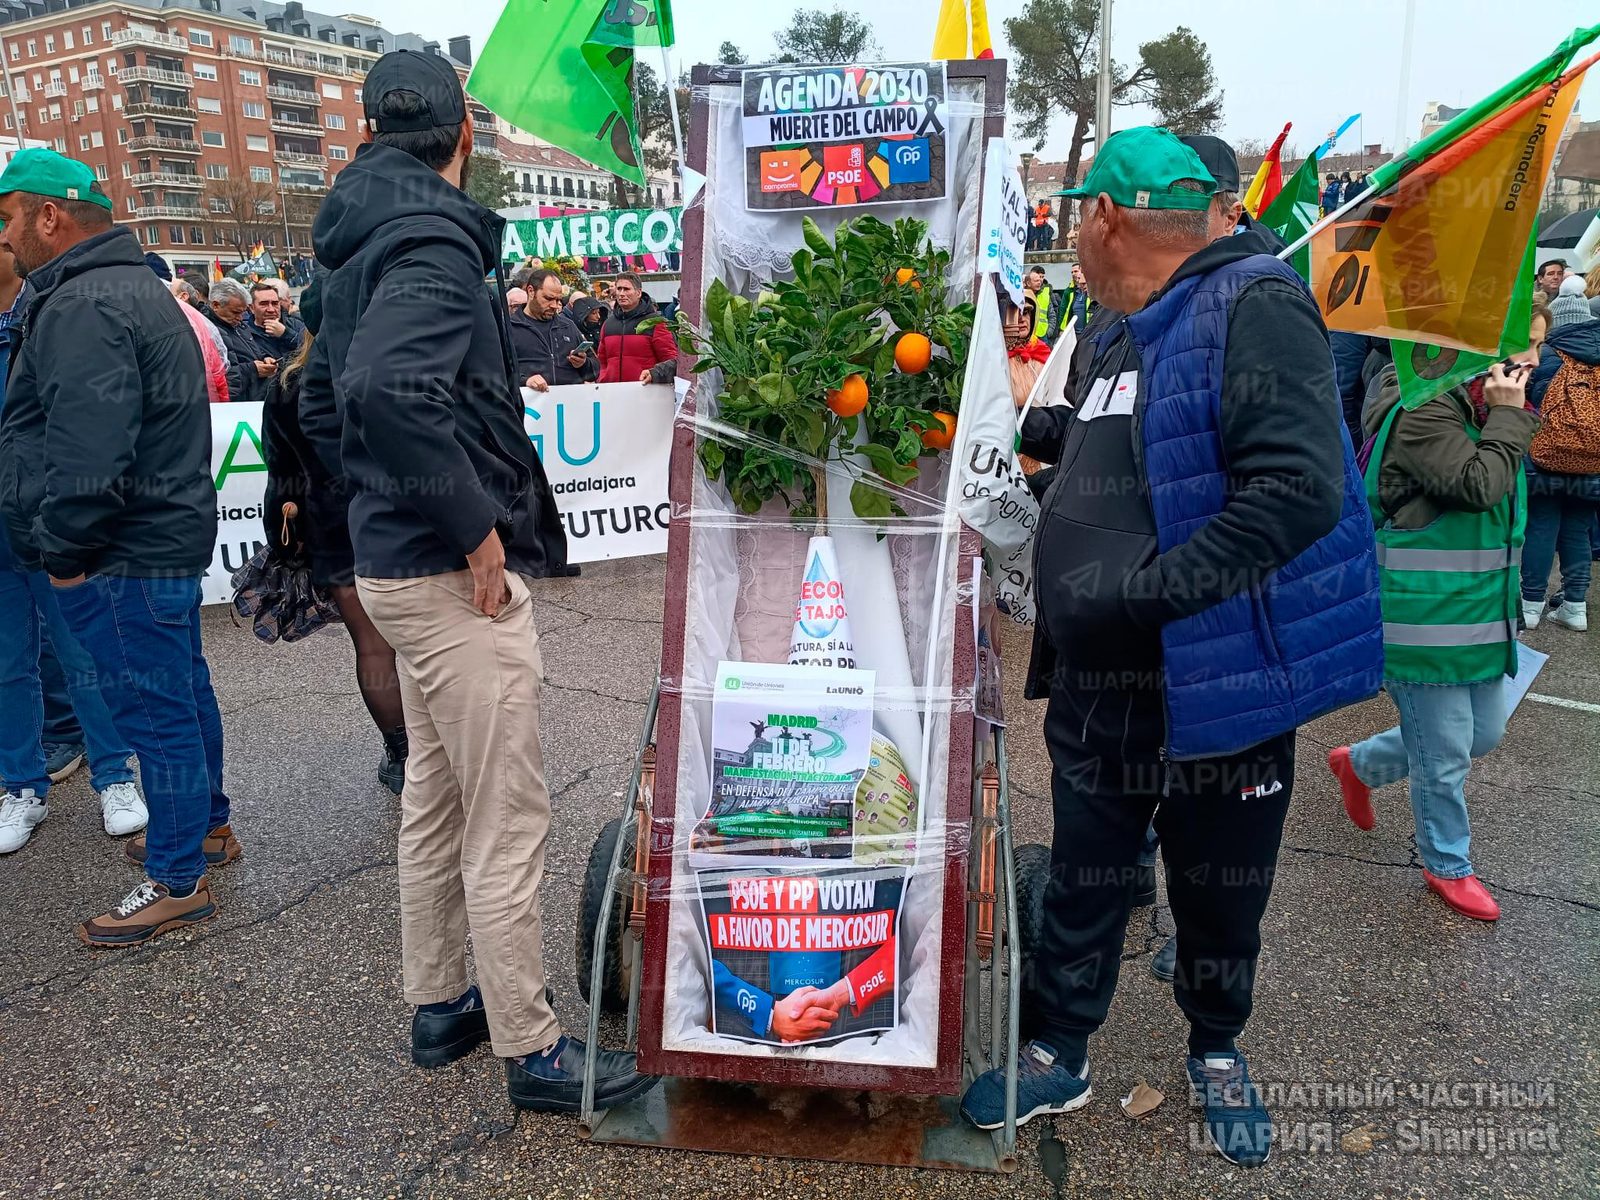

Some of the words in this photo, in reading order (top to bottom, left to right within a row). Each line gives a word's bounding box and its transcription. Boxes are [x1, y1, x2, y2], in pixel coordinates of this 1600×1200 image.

[757, 72, 860, 113] AGENDA
[862, 68, 929, 104] 2030
[1544, 75, 1566, 107] ora
[770, 114, 829, 142] MUERTE
[833, 111, 861, 137] DEL
[863, 107, 918, 135] CAMPO
[827, 170, 862, 185] PSOE
[1504, 123, 1548, 212] Ramadera
[1008, 190, 1020, 217] AL
[1005, 265, 1023, 291] SEC
[767, 714, 818, 729] MADRID
[791, 739, 810, 756] DE
[753, 752, 827, 773] FEBRERO
[721, 783, 734, 796] EN
[735, 784, 774, 798] DEFENSA
[1240, 780, 1283, 801] FILA
[730, 878, 769, 911] PSOE
[773, 878, 785, 909] Y
[789, 880, 814, 911] PP
[818, 879, 875, 911] VOTAN
[718, 921, 729, 946] A
[730, 919, 773, 949] FAVOR
[777, 919, 800, 948] DE
[804, 912, 889, 949] MERCOSUR
[784, 977, 825, 986] MERCOSUR
[859, 971, 886, 998] PSOE
